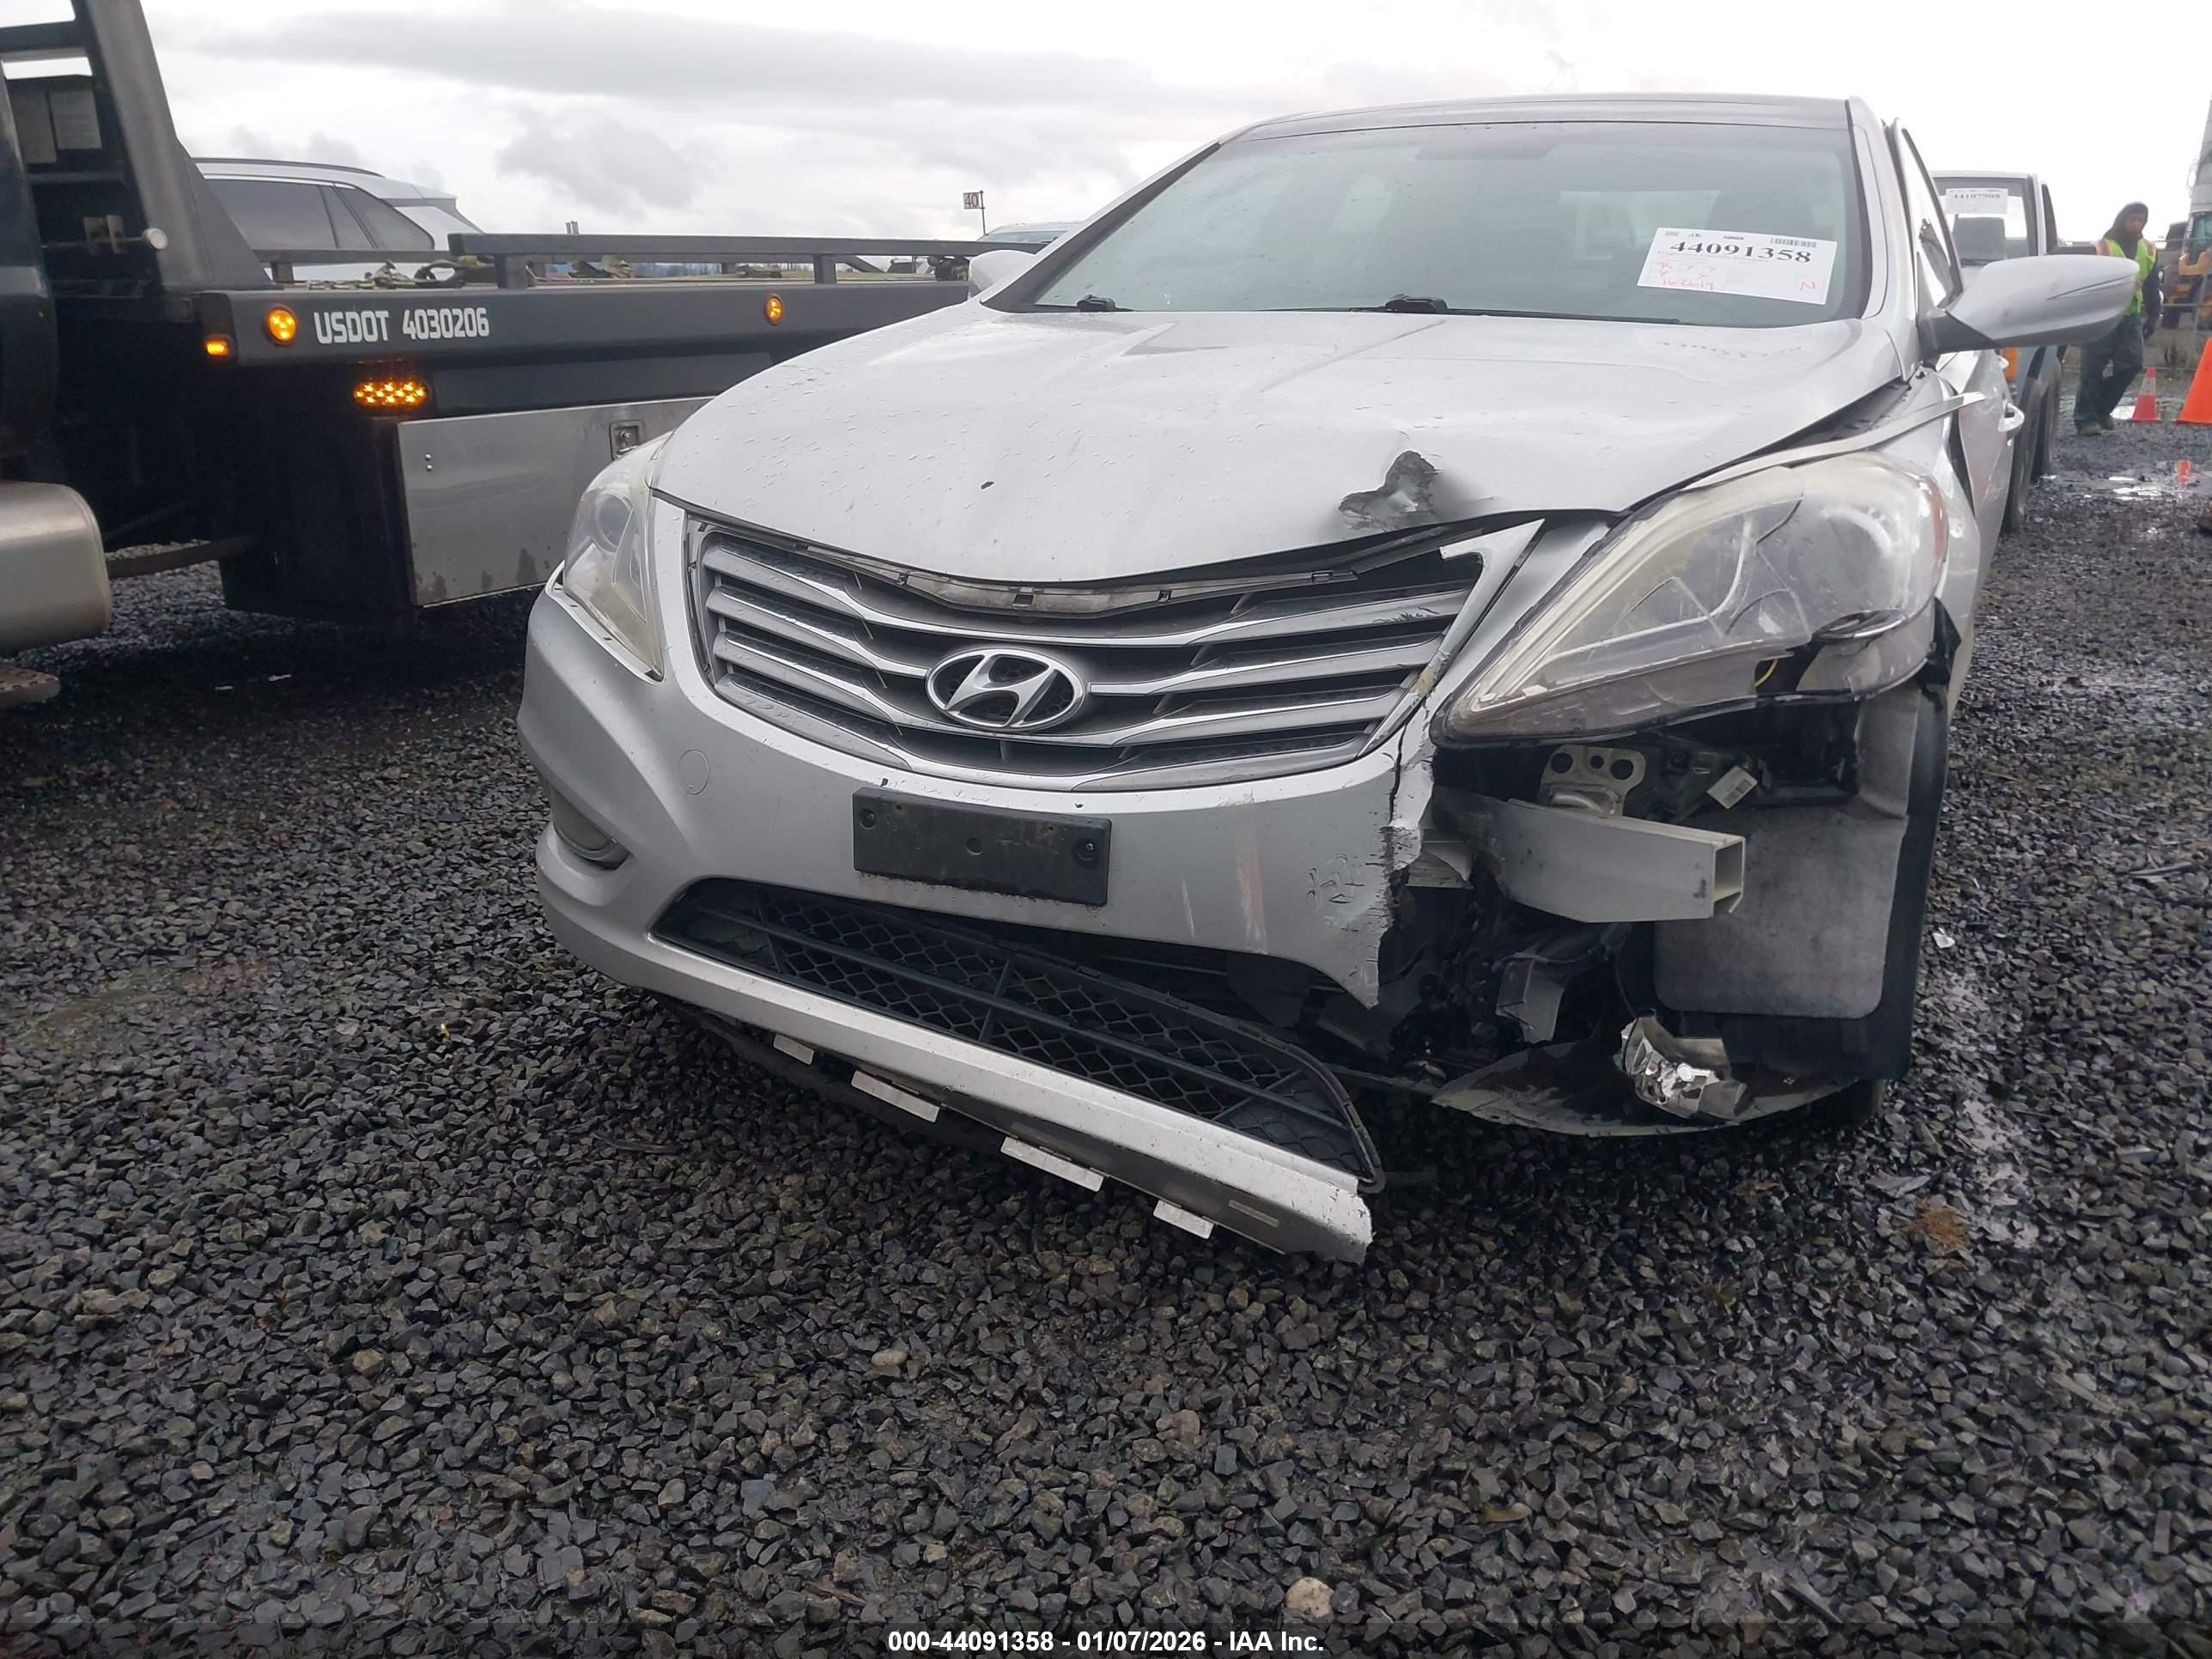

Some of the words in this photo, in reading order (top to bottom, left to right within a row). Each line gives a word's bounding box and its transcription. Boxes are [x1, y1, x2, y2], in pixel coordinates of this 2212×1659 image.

[964, 192, 979, 208] 40
[1670, 240, 1812, 263] 44091358
[313, 310, 390, 344] USDOT
[402, 307, 490, 340] 4030206
